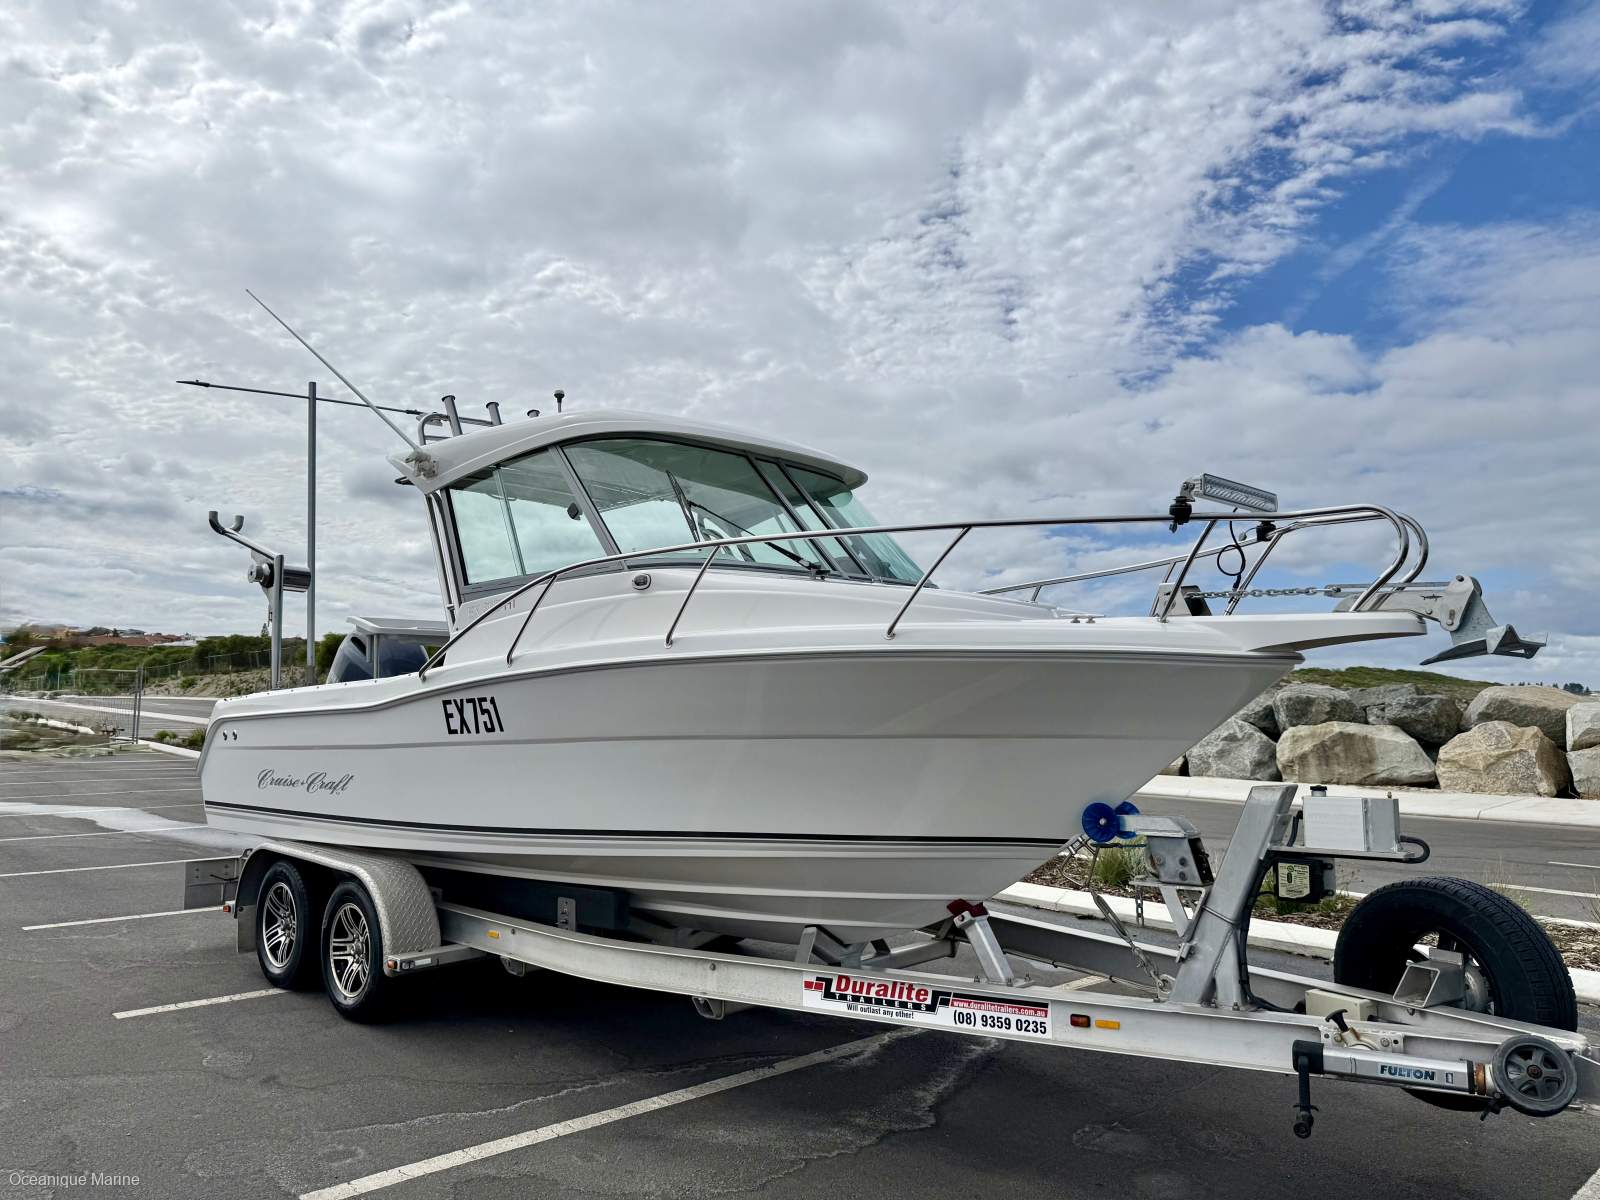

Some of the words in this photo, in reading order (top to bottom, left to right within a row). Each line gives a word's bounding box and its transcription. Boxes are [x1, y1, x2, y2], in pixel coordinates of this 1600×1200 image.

[442, 696, 504, 735] EX751
[306, 771, 355, 795] Craft
[835, 975, 929, 1003] Duralite
[835, 994, 927, 1011] TRAILERS
[846, 1003, 859, 1012] Will
[859, 1005, 881, 1015] outlast
[882, 1008, 894, 1018] any
[895, 1010, 914, 1019] other!
[953, 1000, 1046, 1017] www.duralitetrailers.com.au
[953, 1009, 977, 1027] (08)
[981, 1014, 1011, 1030] 9359
[1016, 1018, 1047, 1034] 0235
[1380, 1064, 1435, 1081] FULTON
